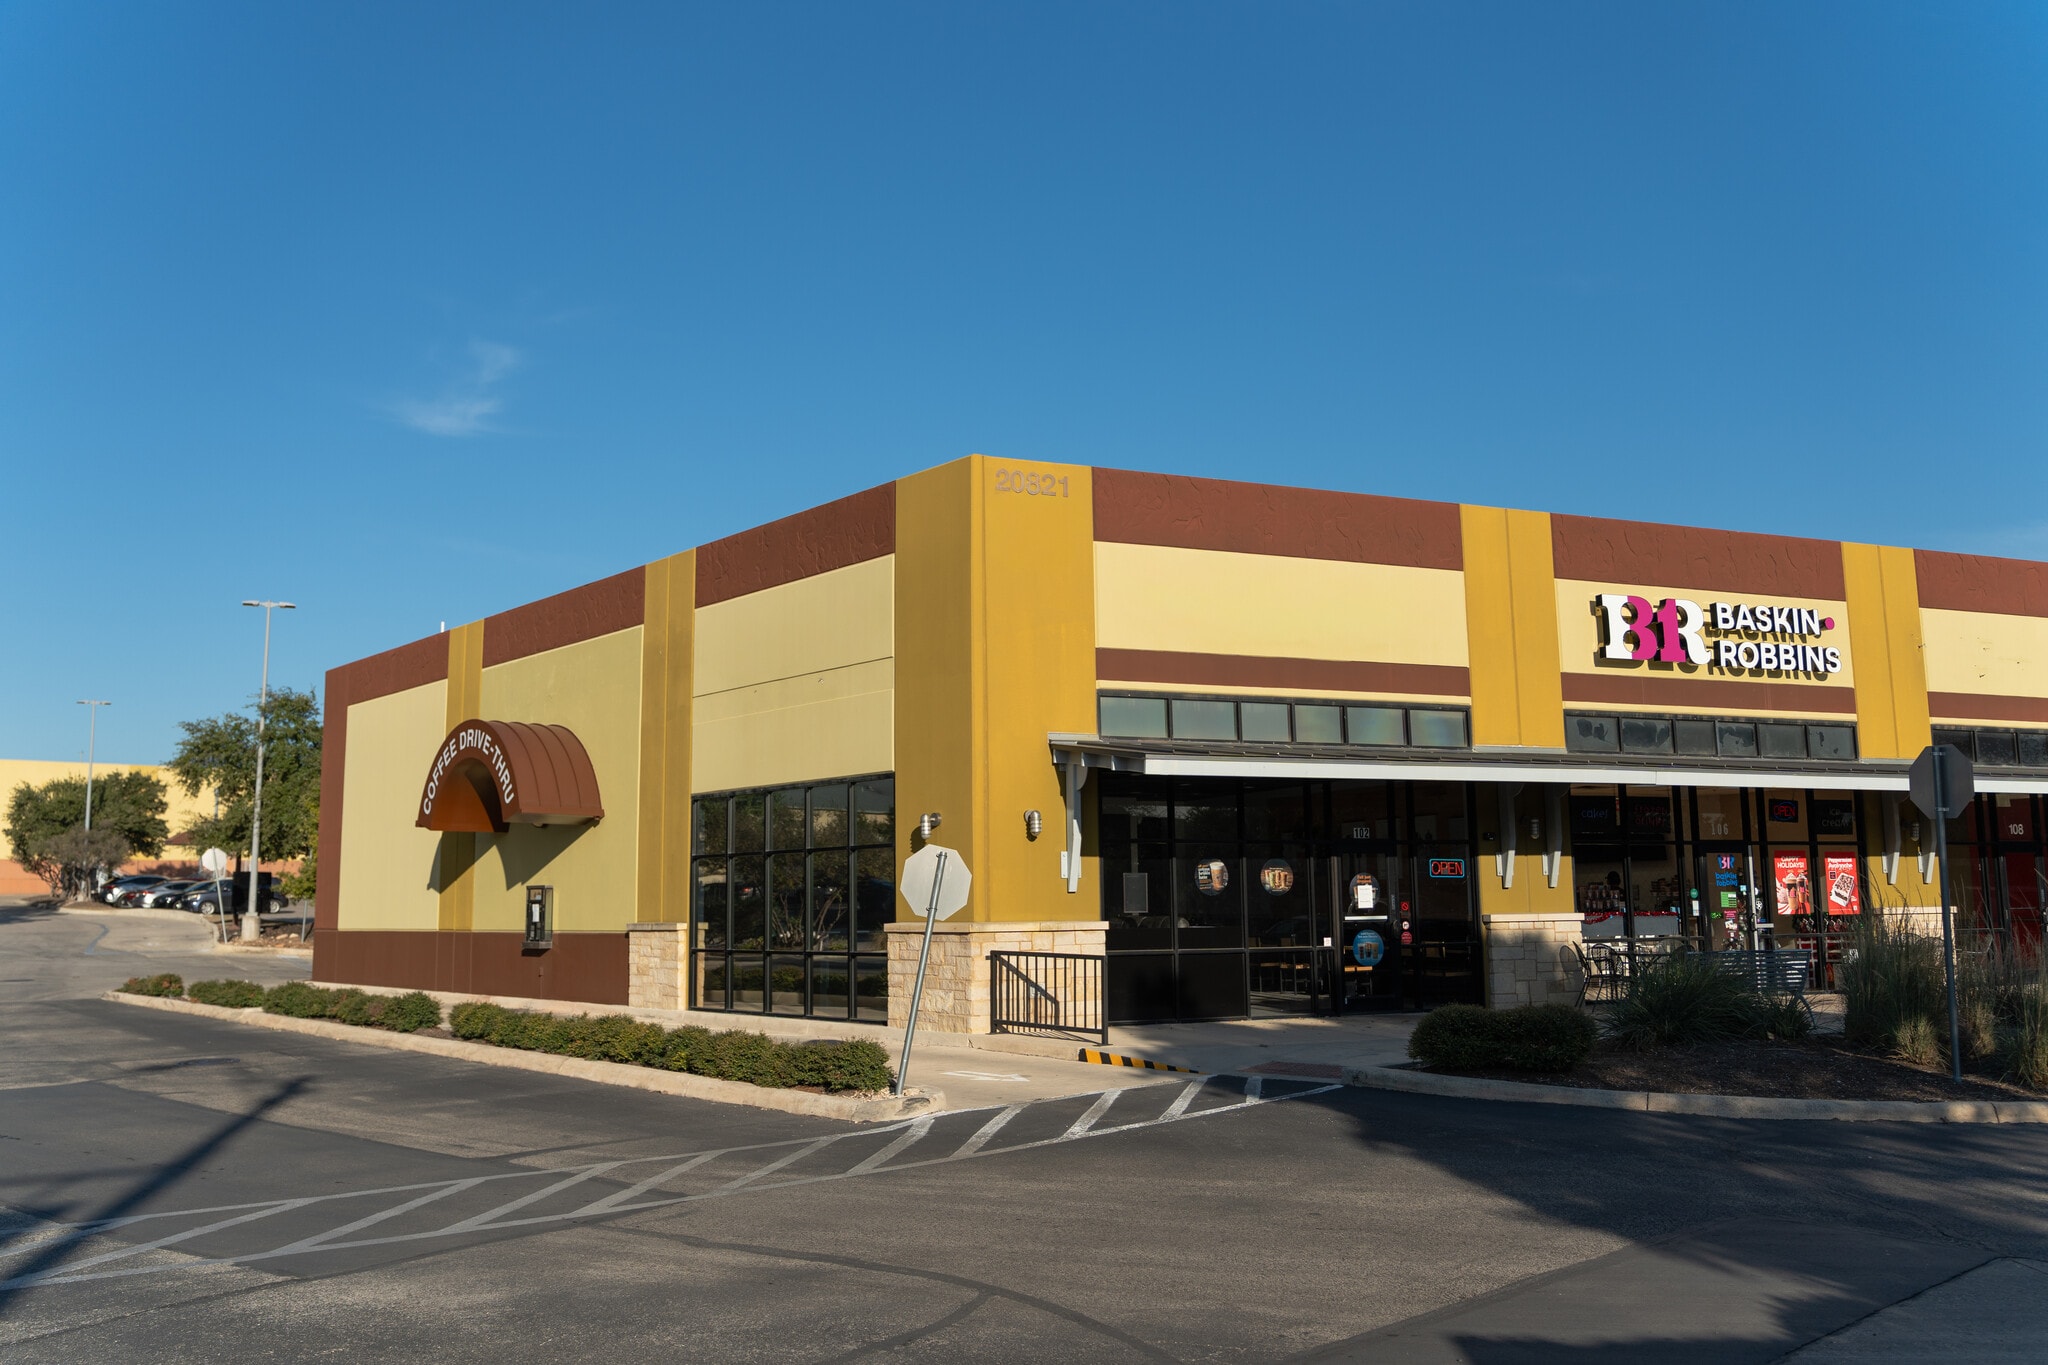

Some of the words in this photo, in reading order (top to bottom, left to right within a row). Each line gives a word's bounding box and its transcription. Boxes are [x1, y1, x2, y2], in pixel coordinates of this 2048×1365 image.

[995, 468, 1069, 498] 20821
[1714, 602, 1821, 636] BASKIN
[1720, 640, 1842, 674] ROBBINS
[423, 738, 458, 815] COFFEE
[459, 728, 515, 804] DRIVE-THRU
[1774, 805, 1796, 817] OPEN
[1353, 828, 1369, 838] 102
[1711, 823, 1729, 835] 106
[2008, 823, 2024, 835] 108
[1431, 861, 1463, 875] OPEN
[1777, 861, 1805, 869] HOLIDAYS!
